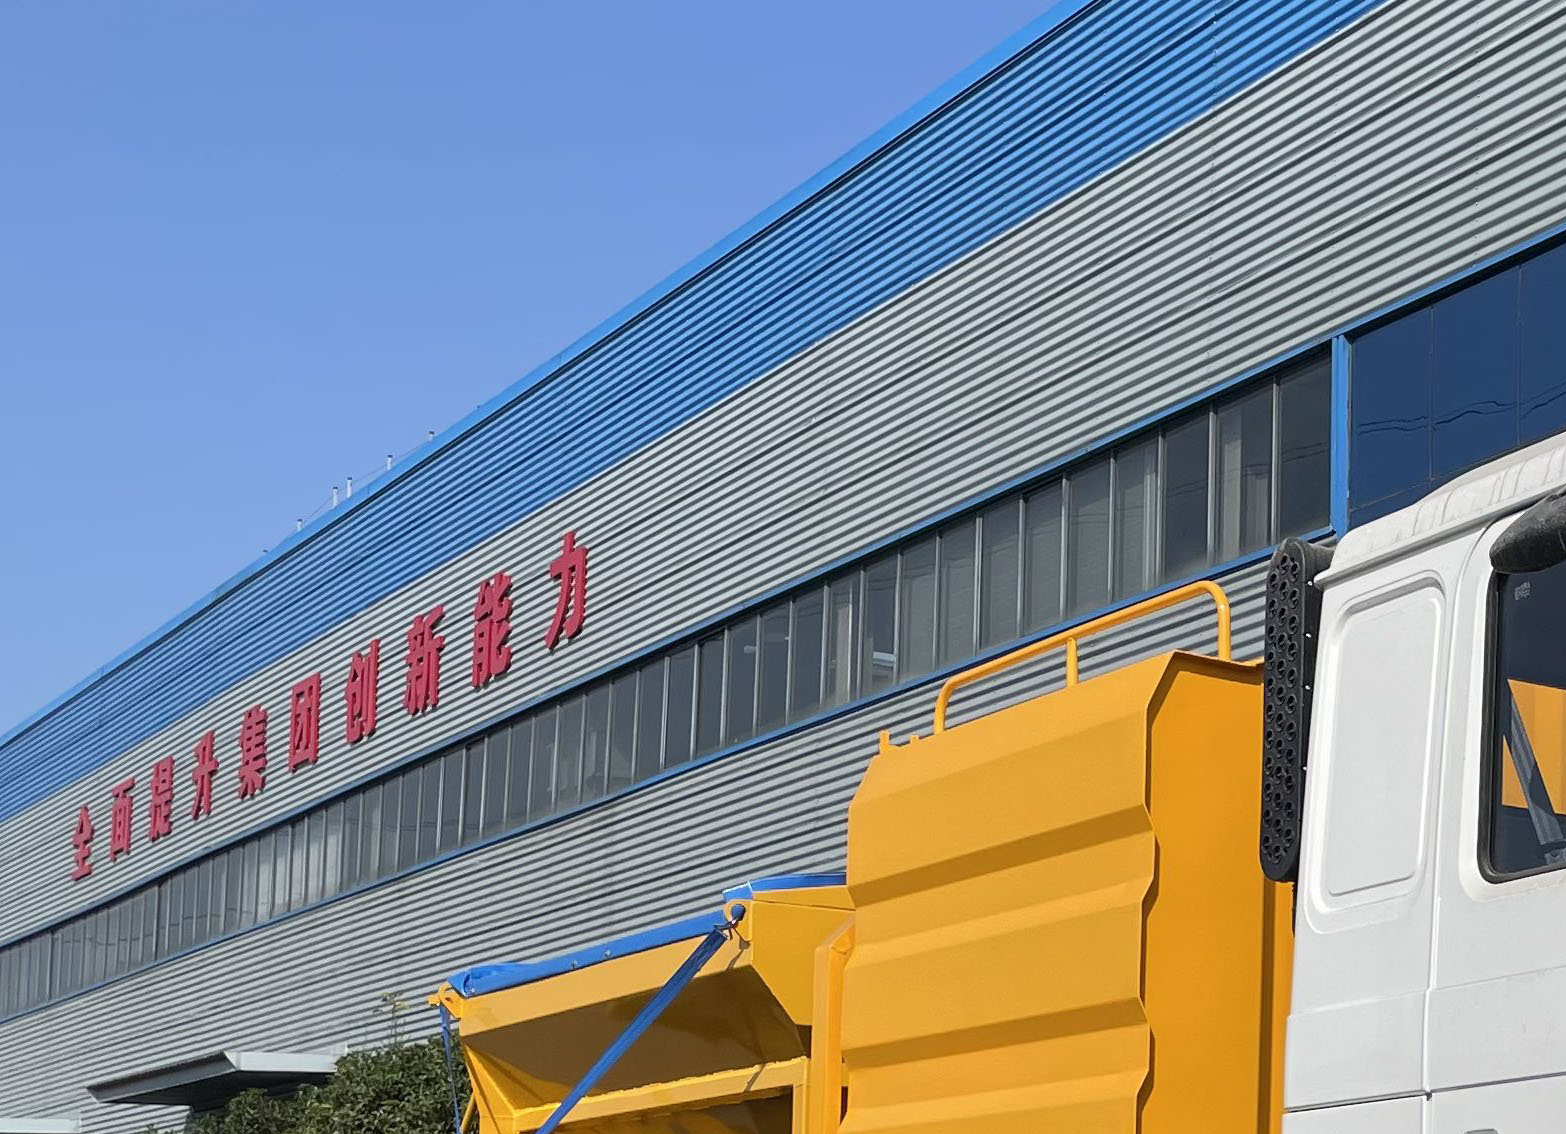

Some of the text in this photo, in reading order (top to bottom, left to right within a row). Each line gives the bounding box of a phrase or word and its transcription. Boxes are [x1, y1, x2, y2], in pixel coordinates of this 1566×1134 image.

[71, 531, 588, 881] 全面提升集团创新能力
